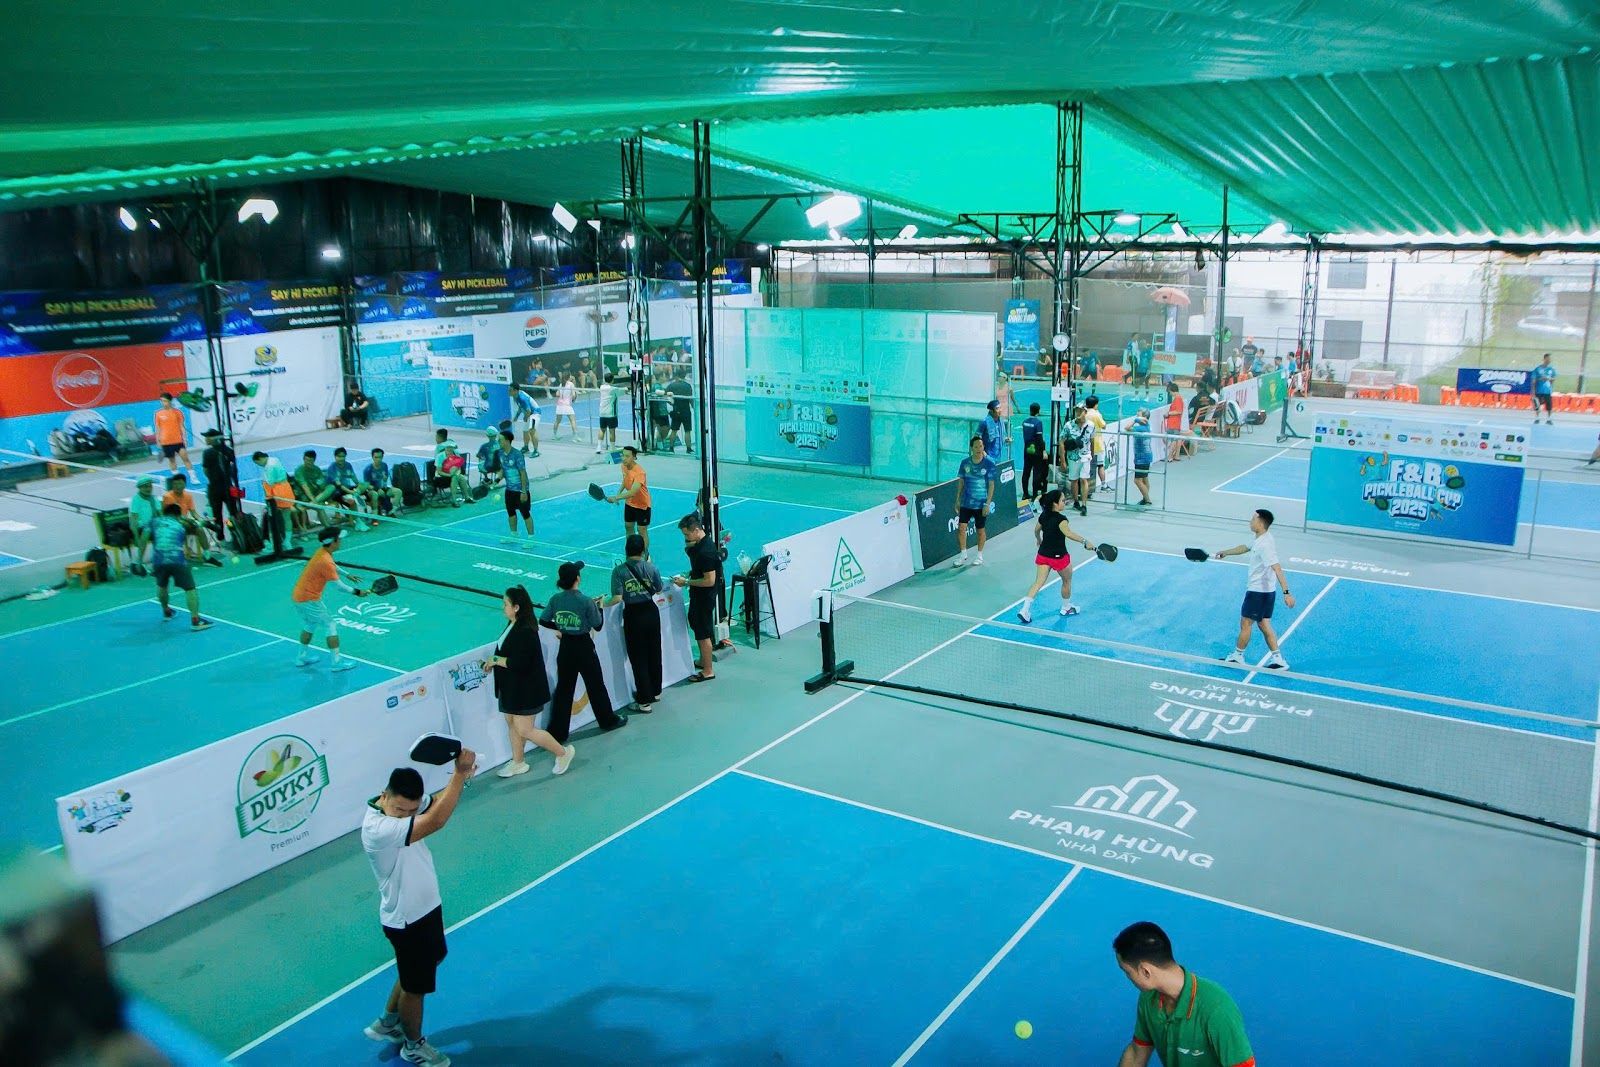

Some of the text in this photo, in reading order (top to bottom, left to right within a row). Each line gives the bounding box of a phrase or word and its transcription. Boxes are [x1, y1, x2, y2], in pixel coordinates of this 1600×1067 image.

[466, 277, 508, 288] PICKLEBALL
[525, 328, 548, 338] PEPSI
[1158, 393, 1164, 402] 5
[1296, 403, 1304, 412] 6
[288, 404, 309, 415] ANH
[793, 404, 824, 421] F&B
[796, 433, 818, 448] 2025
[1389, 459, 1443, 487] F&B
[1363, 481, 1462, 509] PICKLEBALL CUP
[1391, 499, 1428, 519] 2025
[816, 596, 825, 620] 1
[250, 766, 316, 821] DUYKY
[271, 830, 310, 852] Premium
[1008, 809, 1215, 869] PHẠM HÙNG
[1057, 837, 1142, 865] NHÀ ĐẤT
